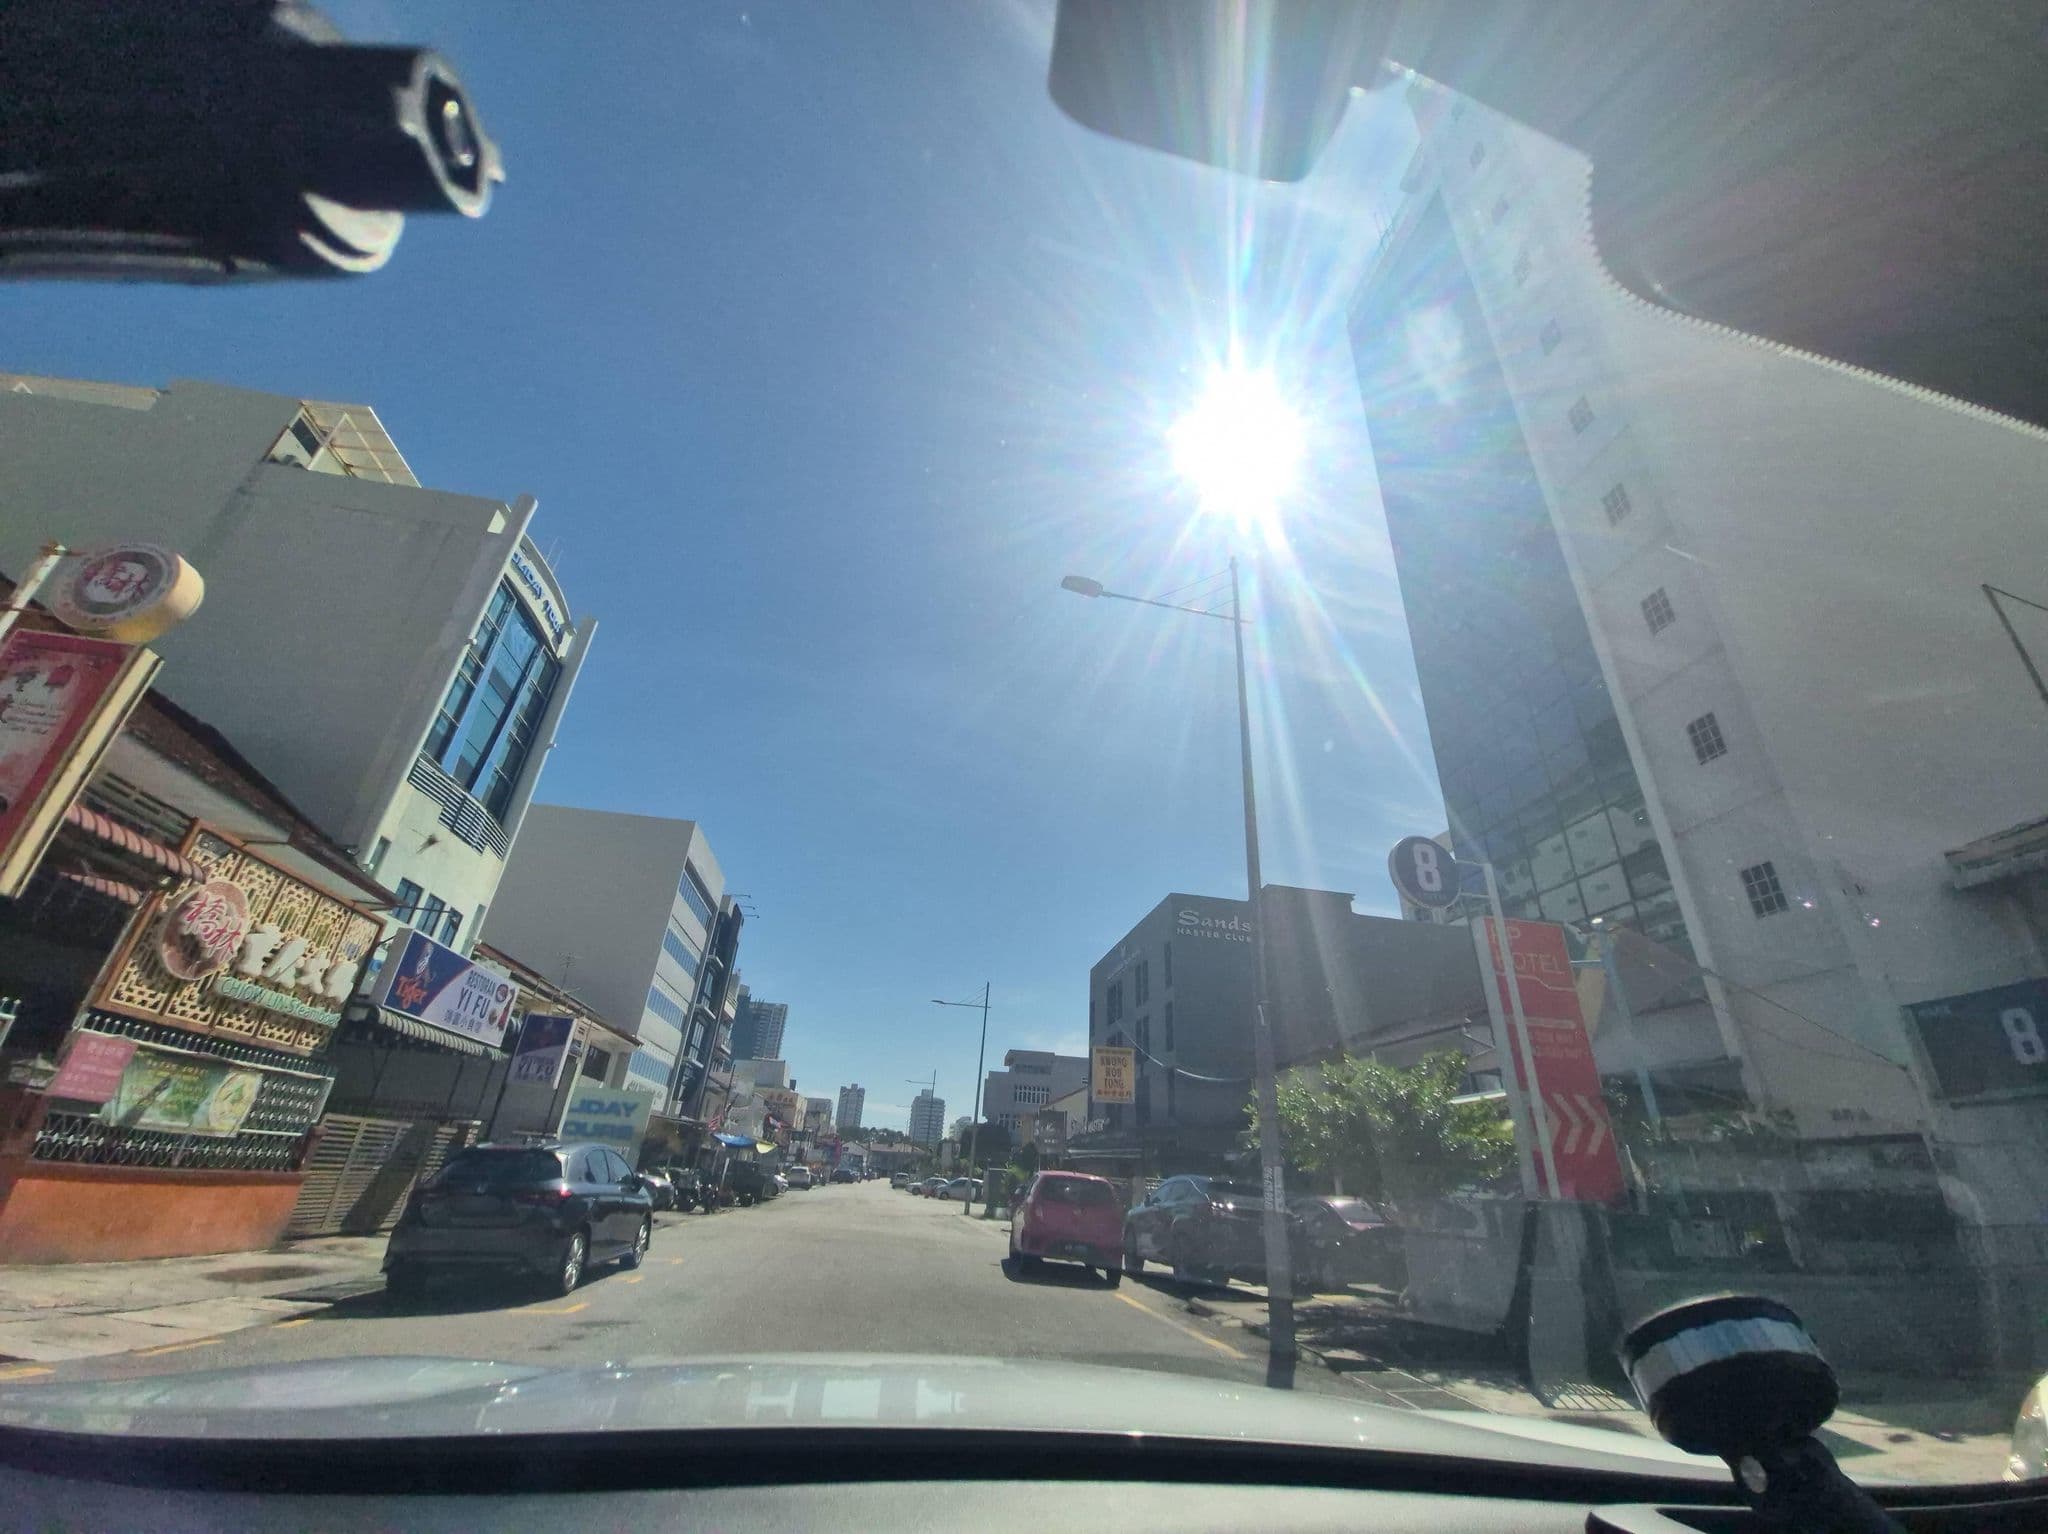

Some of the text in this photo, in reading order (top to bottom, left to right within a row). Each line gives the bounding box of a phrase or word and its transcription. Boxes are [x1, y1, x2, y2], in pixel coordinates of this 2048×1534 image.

[1413, 842, 1442, 892] 8
[1178, 910, 1251, 932] Sands
[466, 969, 497, 997] RESTORAN
[457, 986, 491, 1019] YI FU
[1999, 1008, 2046, 1064] 8
